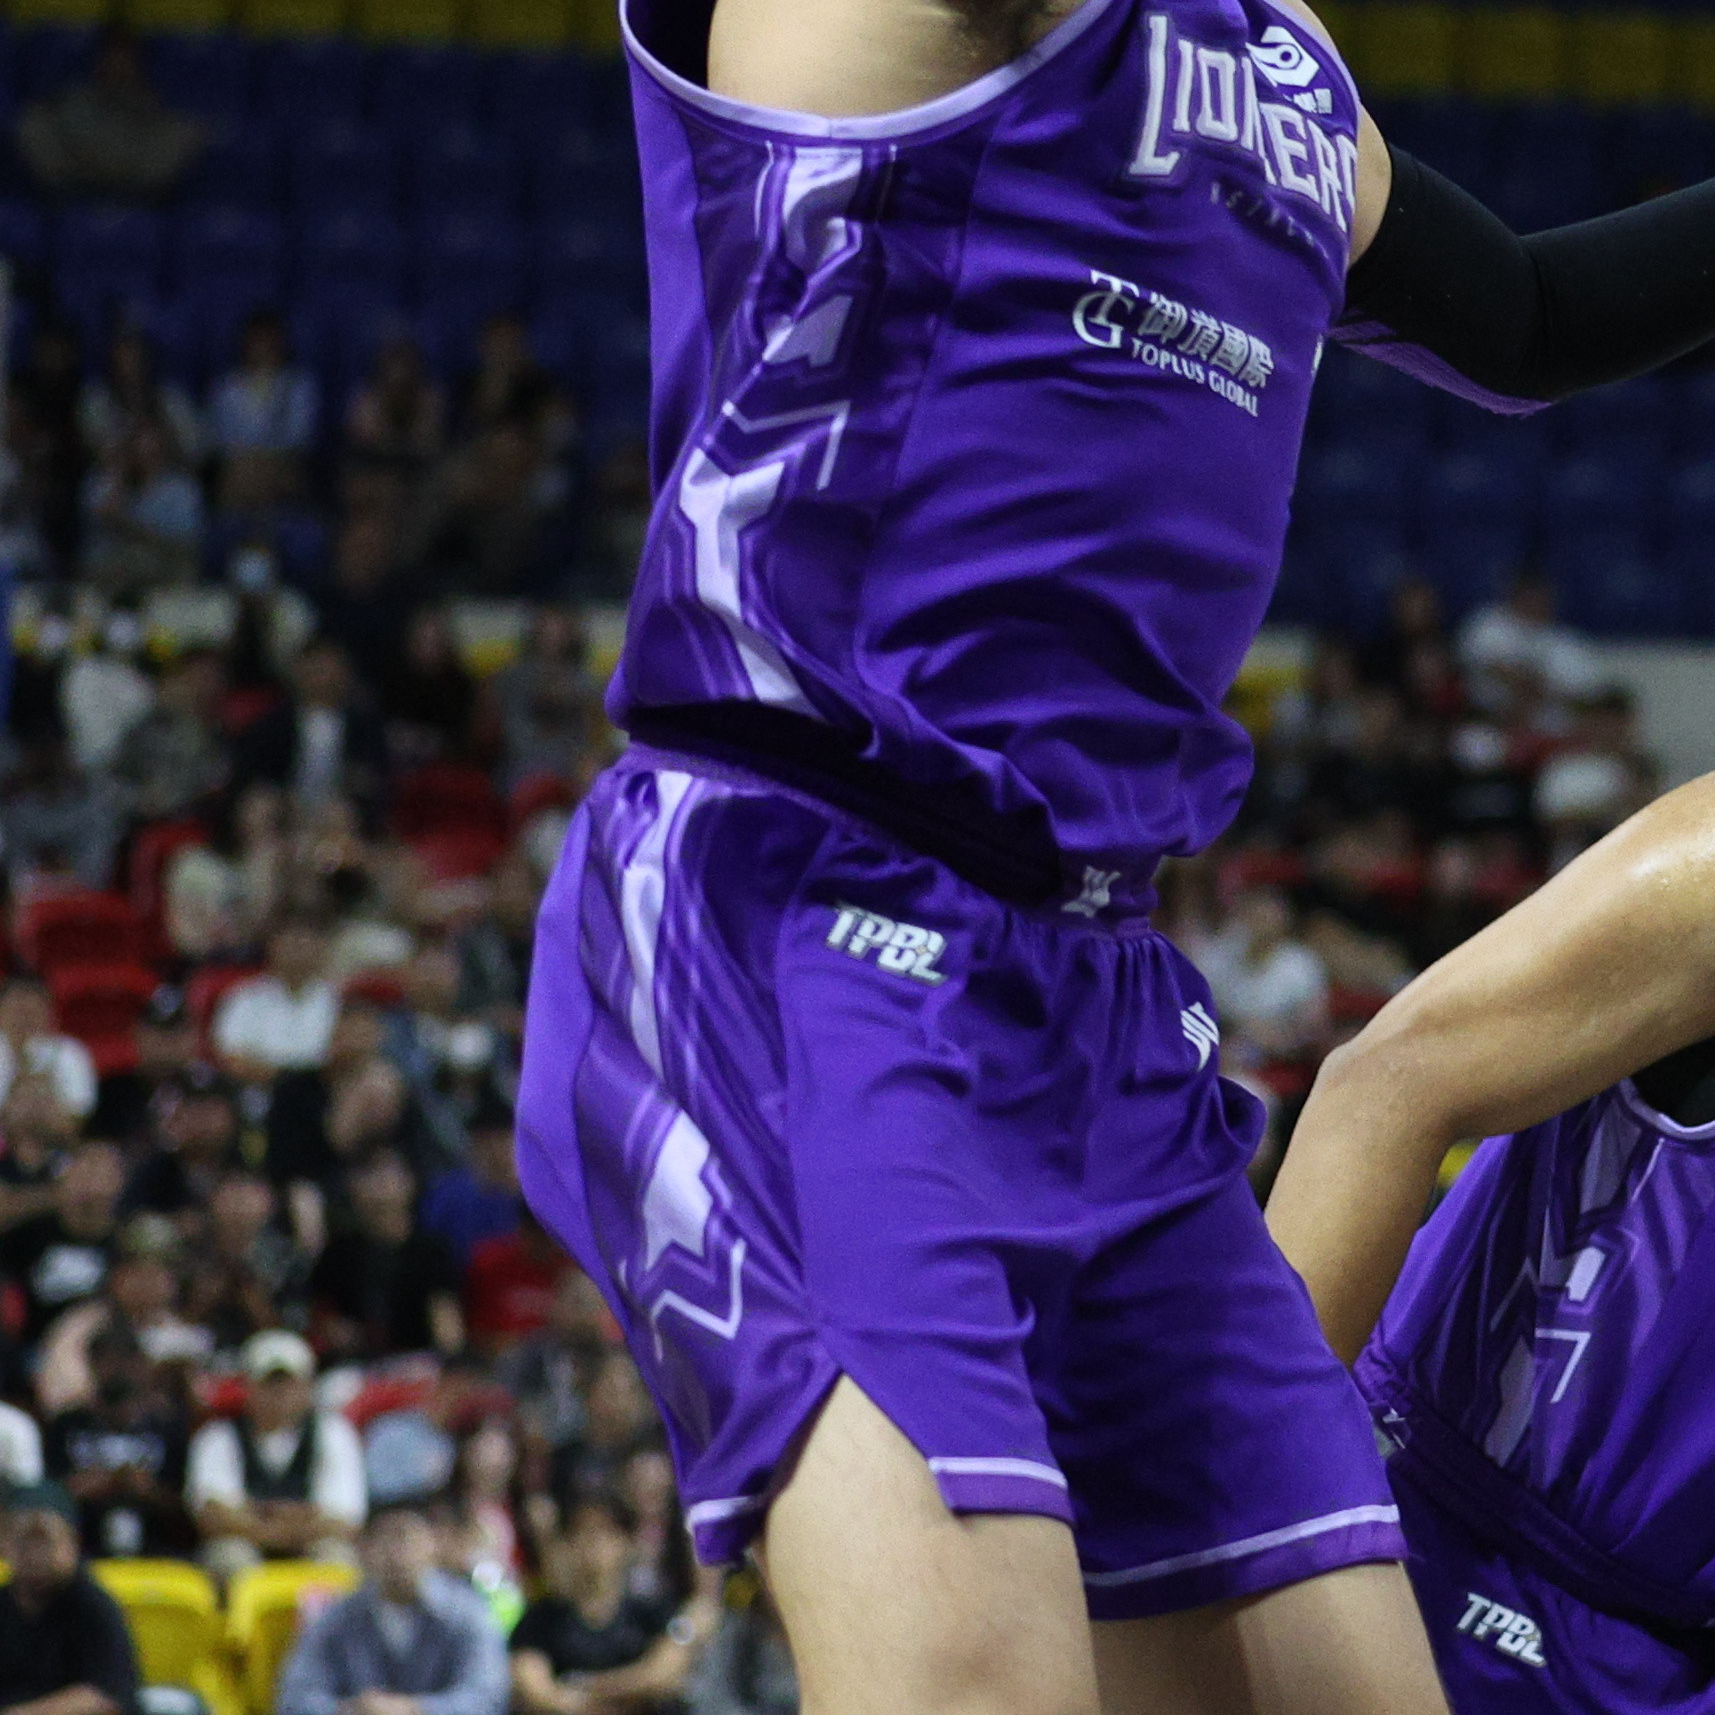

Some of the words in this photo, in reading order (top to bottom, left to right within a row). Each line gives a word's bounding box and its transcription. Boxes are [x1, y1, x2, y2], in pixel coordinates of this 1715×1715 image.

[1131, 337, 1205, 384] TOPLUS
[826, 901, 948, 986] TPBL
[1456, 1591, 1547, 1668] TPBL
